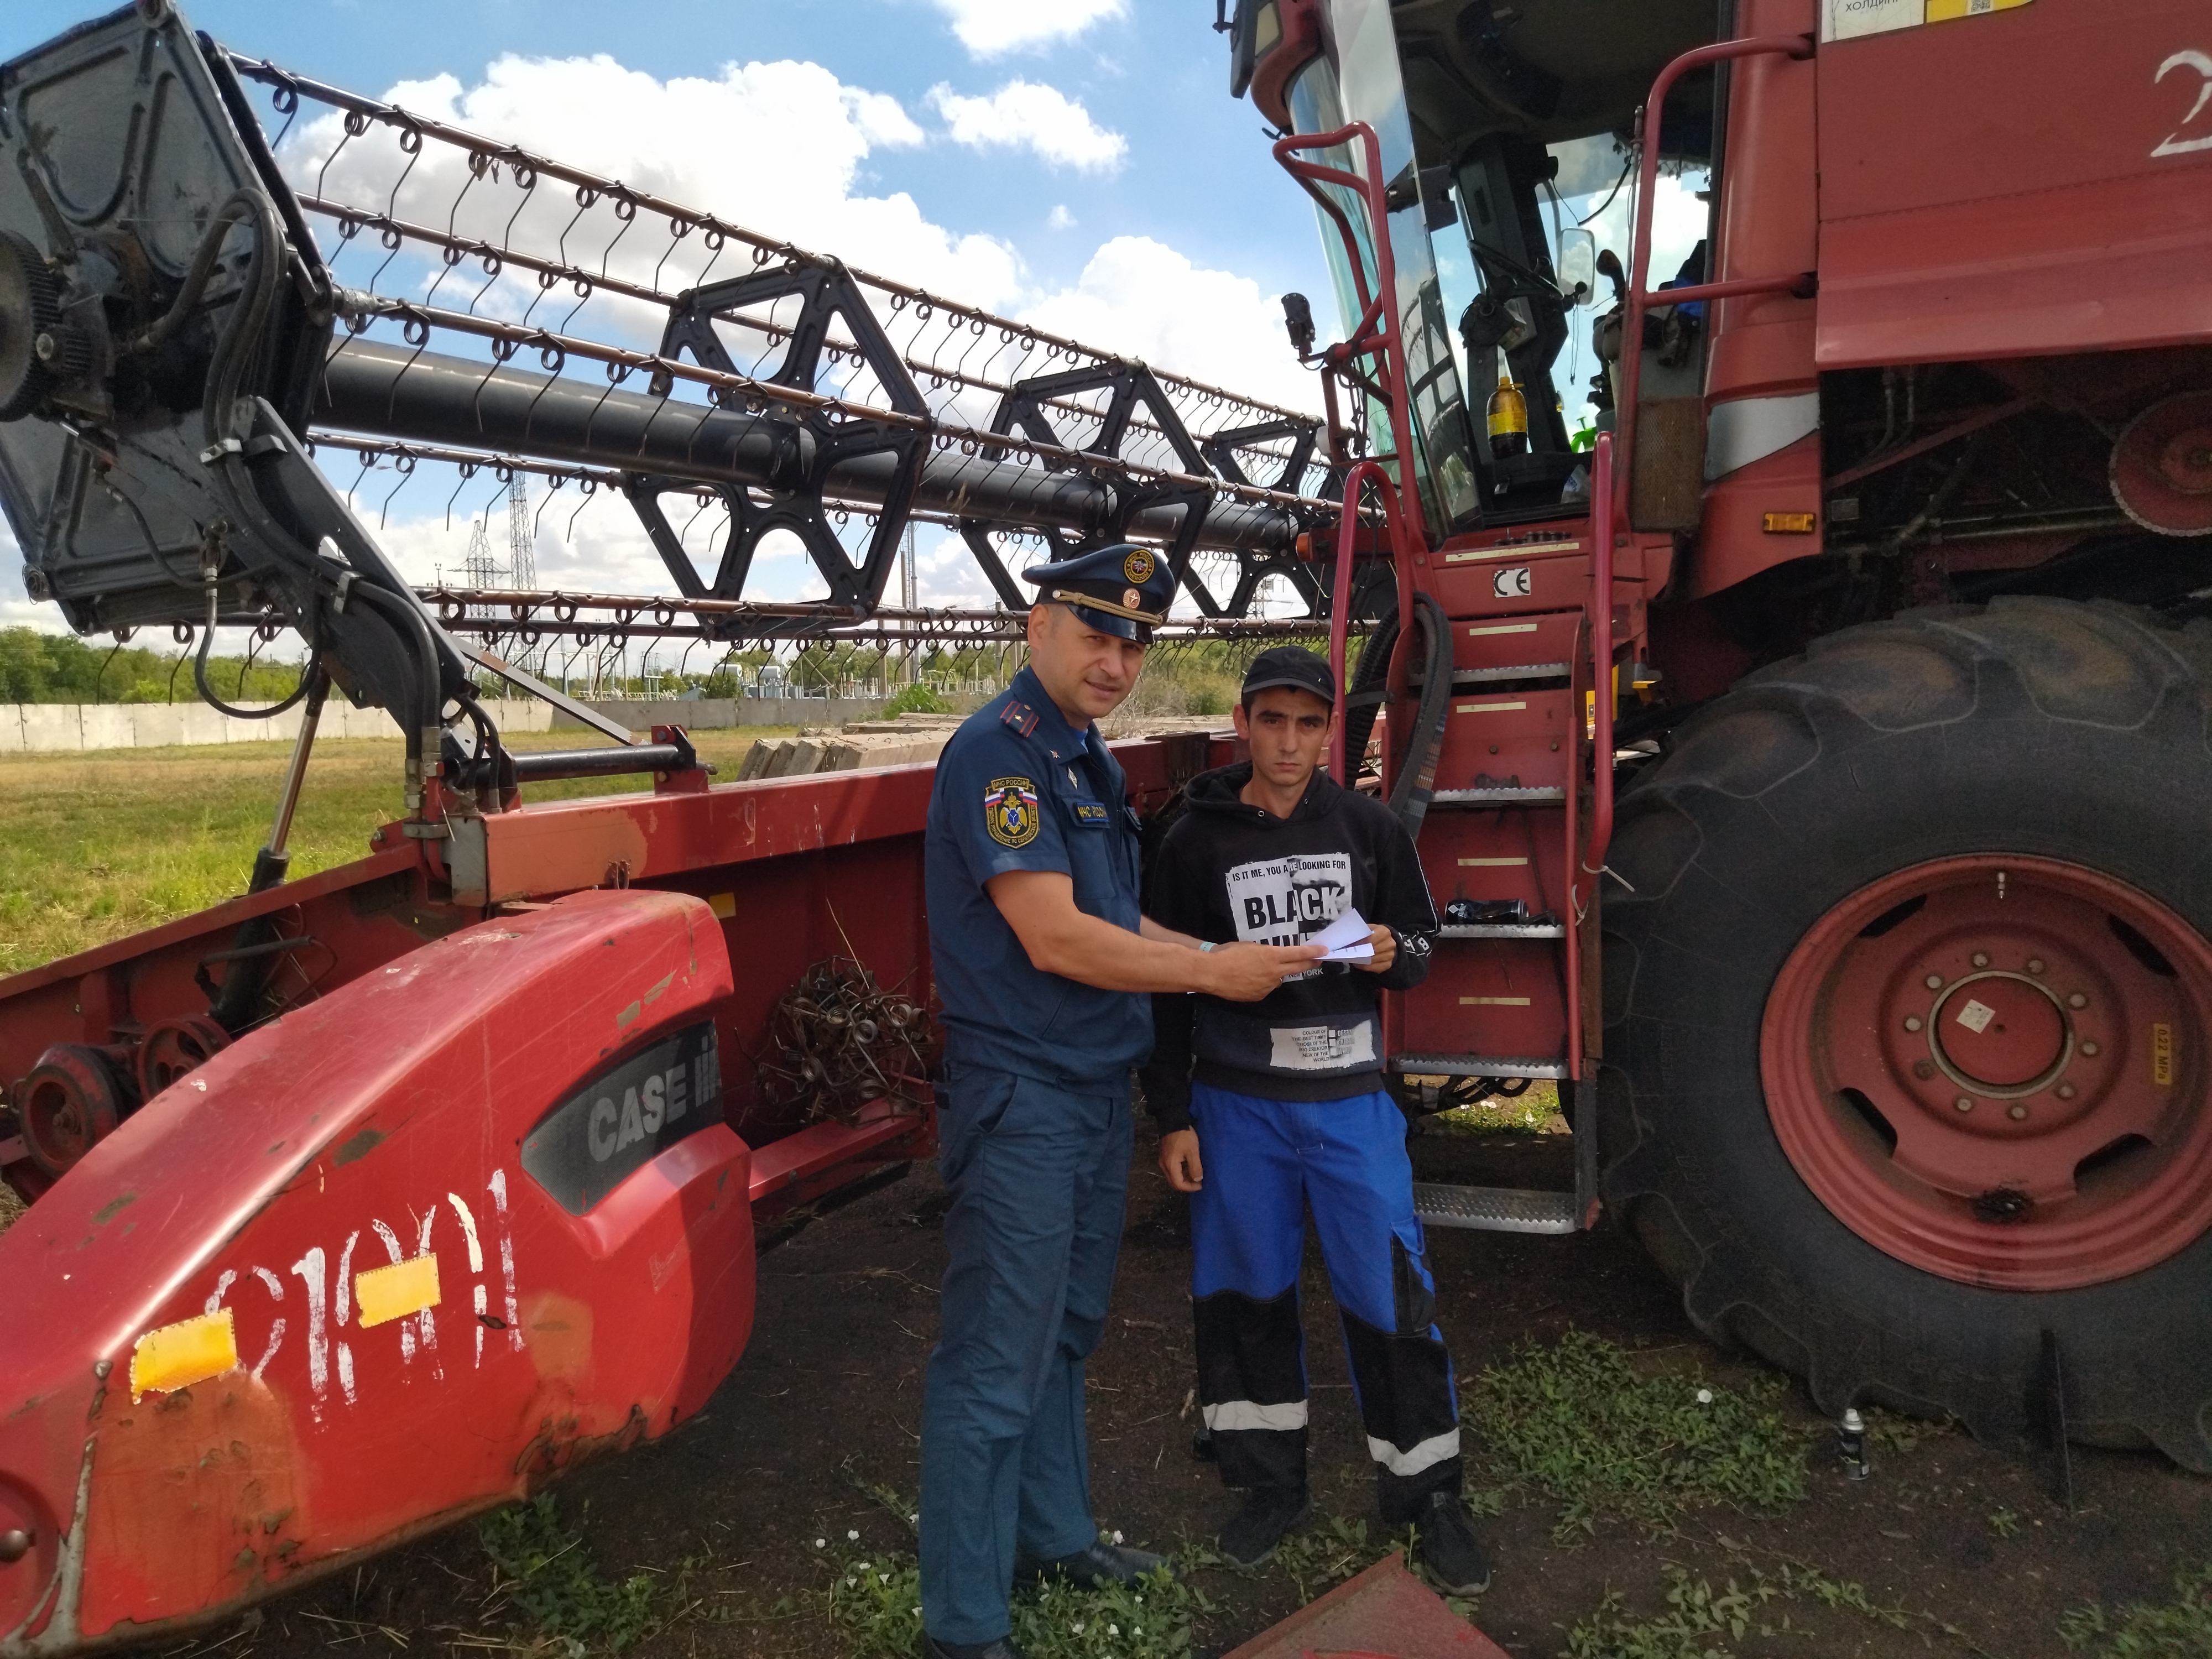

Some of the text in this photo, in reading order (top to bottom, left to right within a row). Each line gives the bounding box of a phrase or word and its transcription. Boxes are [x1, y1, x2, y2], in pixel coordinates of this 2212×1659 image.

[1845, 0, 1898, 12] ХОЛДИ
[1126, 568, 1149, 581] EMERCOM
[1494, 568, 1530, 596] CE
[1077, 806, 1091, 817] МЧС
[1233, 860, 1346, 881] IS IT ME, YOU ARE LOOKING FOR
[1244, 887, 1341, 930] BLACK
[1302, 968, 1323, 977] YORK
[2158, 1056, 2168, 1079] MPa
[588, 1063, 687, 1161] CASE
